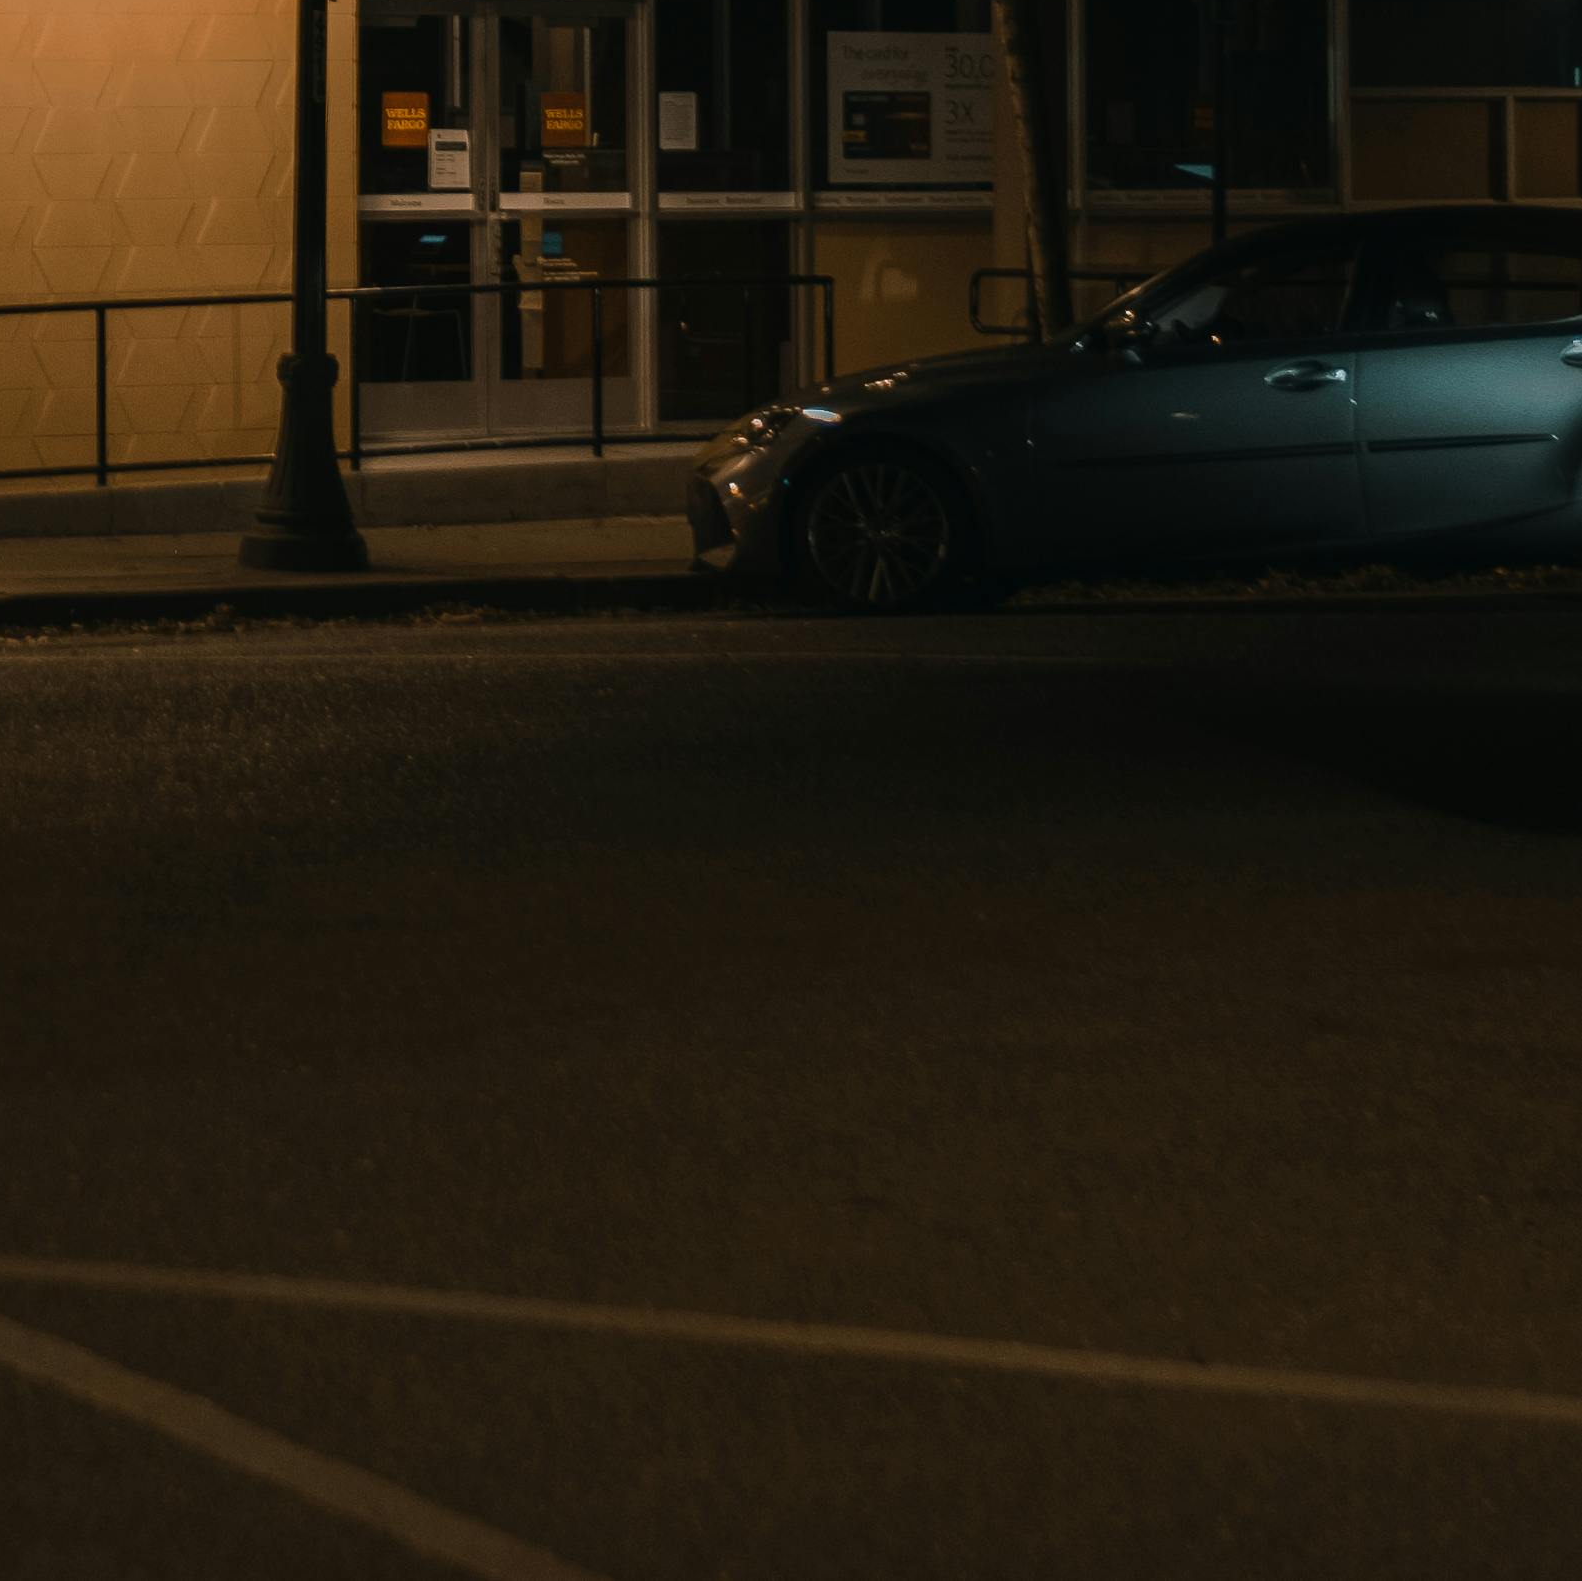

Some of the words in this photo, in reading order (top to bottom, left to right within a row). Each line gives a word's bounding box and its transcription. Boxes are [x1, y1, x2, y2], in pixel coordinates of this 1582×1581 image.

[385, 108, 427, 118] WELLS
[544, 108, 584, 119] WELLS
[944, 99, 974, 124] 3X
[386, 119, 428, 131] FARGO
[545, 119, 584, 131] FARGO
